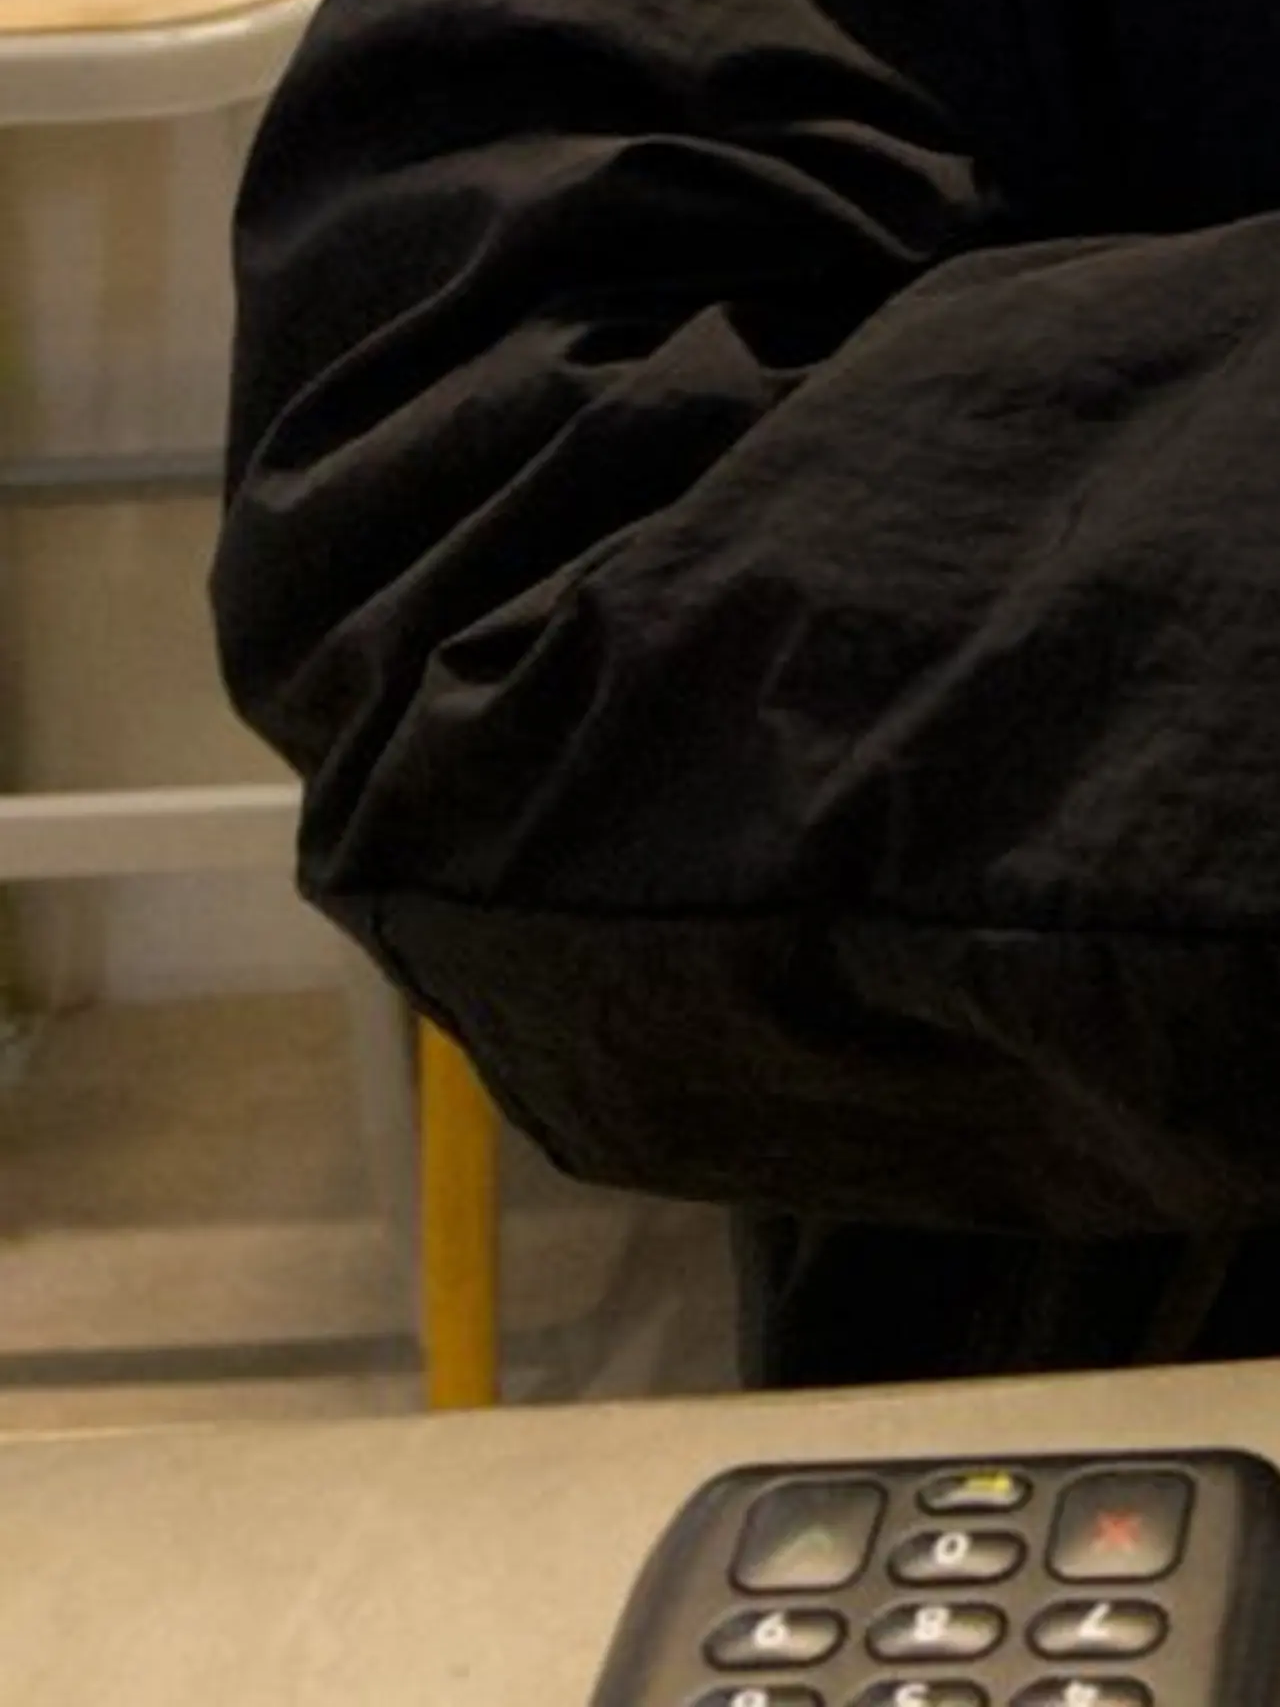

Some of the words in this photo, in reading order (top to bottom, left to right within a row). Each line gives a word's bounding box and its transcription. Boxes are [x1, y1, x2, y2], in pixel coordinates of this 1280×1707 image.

[934, 1530, 969, 1566] 0
[913, 1605, 950, 1641] 8
[1077, 1601, 1112, 1638] 7
